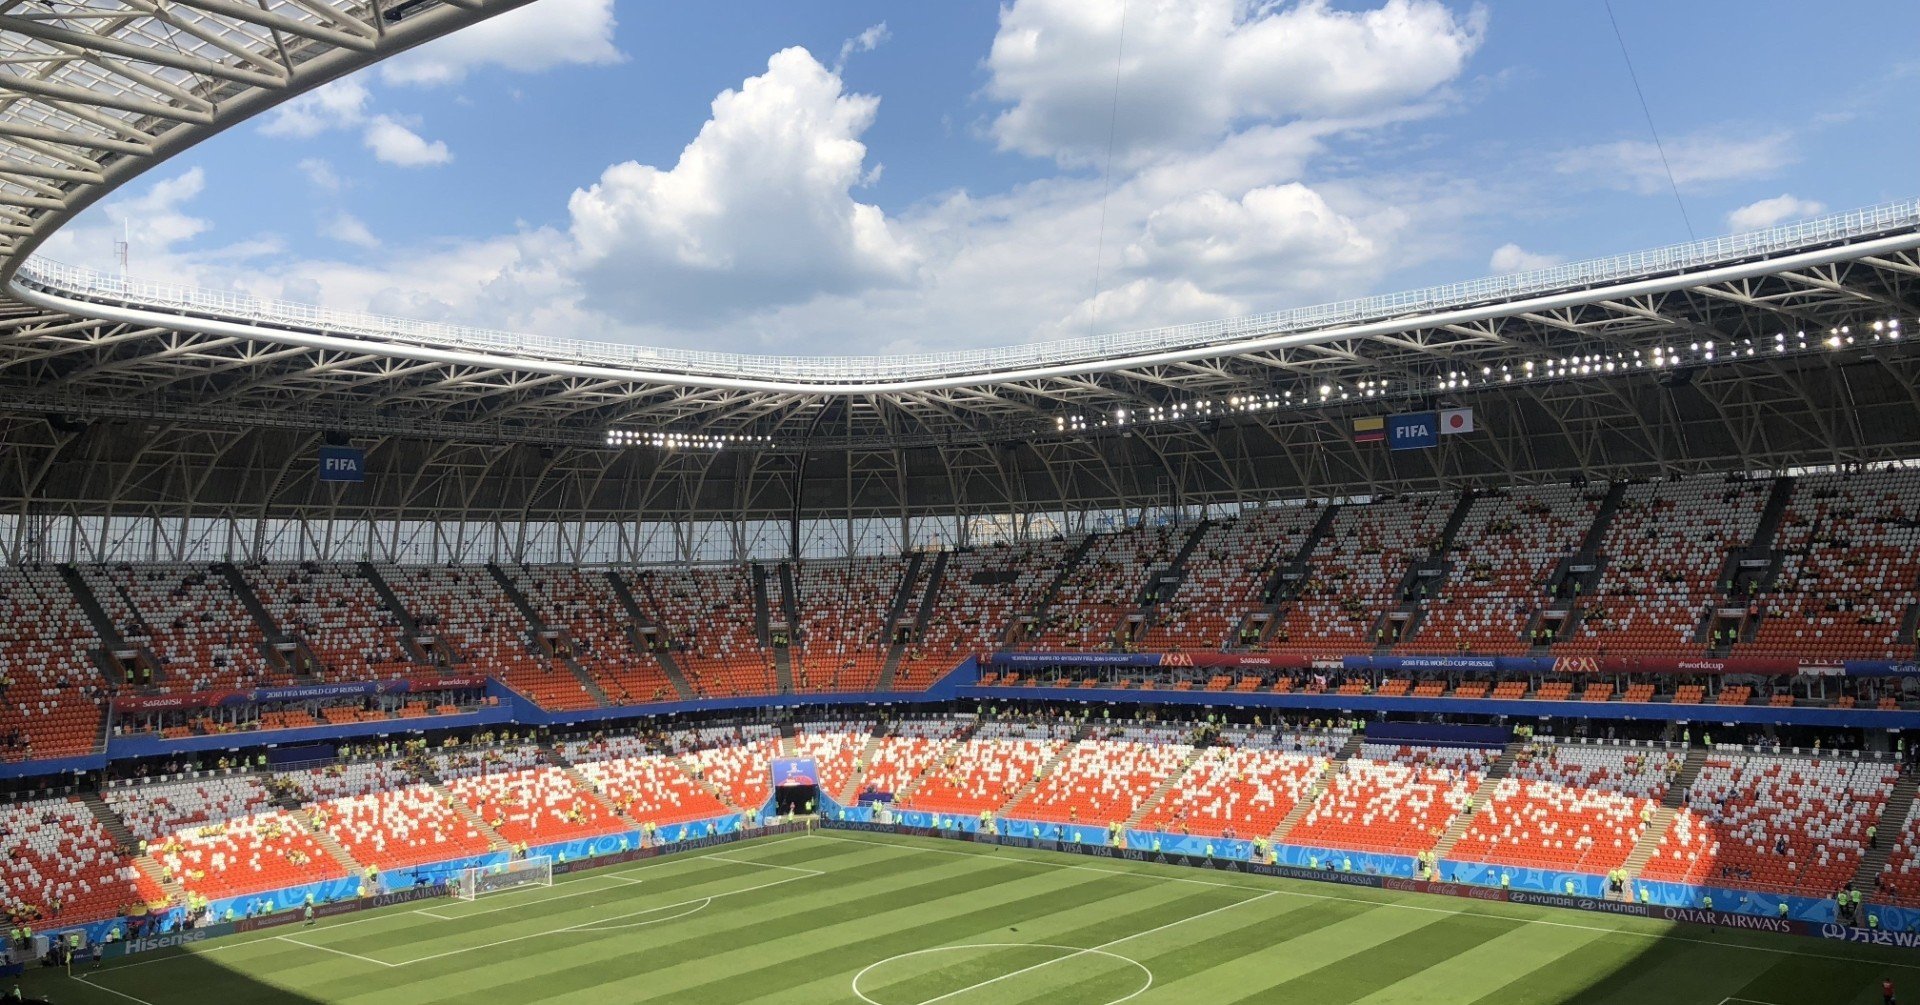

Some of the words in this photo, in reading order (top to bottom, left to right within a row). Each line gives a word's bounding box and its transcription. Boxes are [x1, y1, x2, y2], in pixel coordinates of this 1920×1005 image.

[1396, 424, 1428, 438] FIFA
[326, 458, 357, 471] FIFA
[1240, 657, 1270, 665] SARANSK
[1678, 661, 1724, 671] #worldcup
[437, 678, 470, 687] #worldcup
[299, 688, 324, 696] WORLD
[142, 698, 182, 708] SARANSK
[1062, 842, 1082, 854] VISA
[1091, 845, 1112, 857] VISA
[1122, 850, 1144, 860] VISA
[1254, 865, 1271, 874] 2018
[1272, 867, 1289, 876] FIFA
[1290, 869, 1320, 879] WORLD
[1321, 872, 1339, 880] CUP
[1340, 874, 1372, 884] RUSSIA
[373, 892, 410, 906] QATAR
[1528, 894, 1573, 906] HYUNDAI
[1598, 901, 1646, 914] HYUNDAI
[1664, 907, 1717, 924] QATAR
[1721, 913, 1790, 932] AIRWAYS
[1850, 926, 1893, 945] 万达
[125, 930, 206, 954] Hisense
